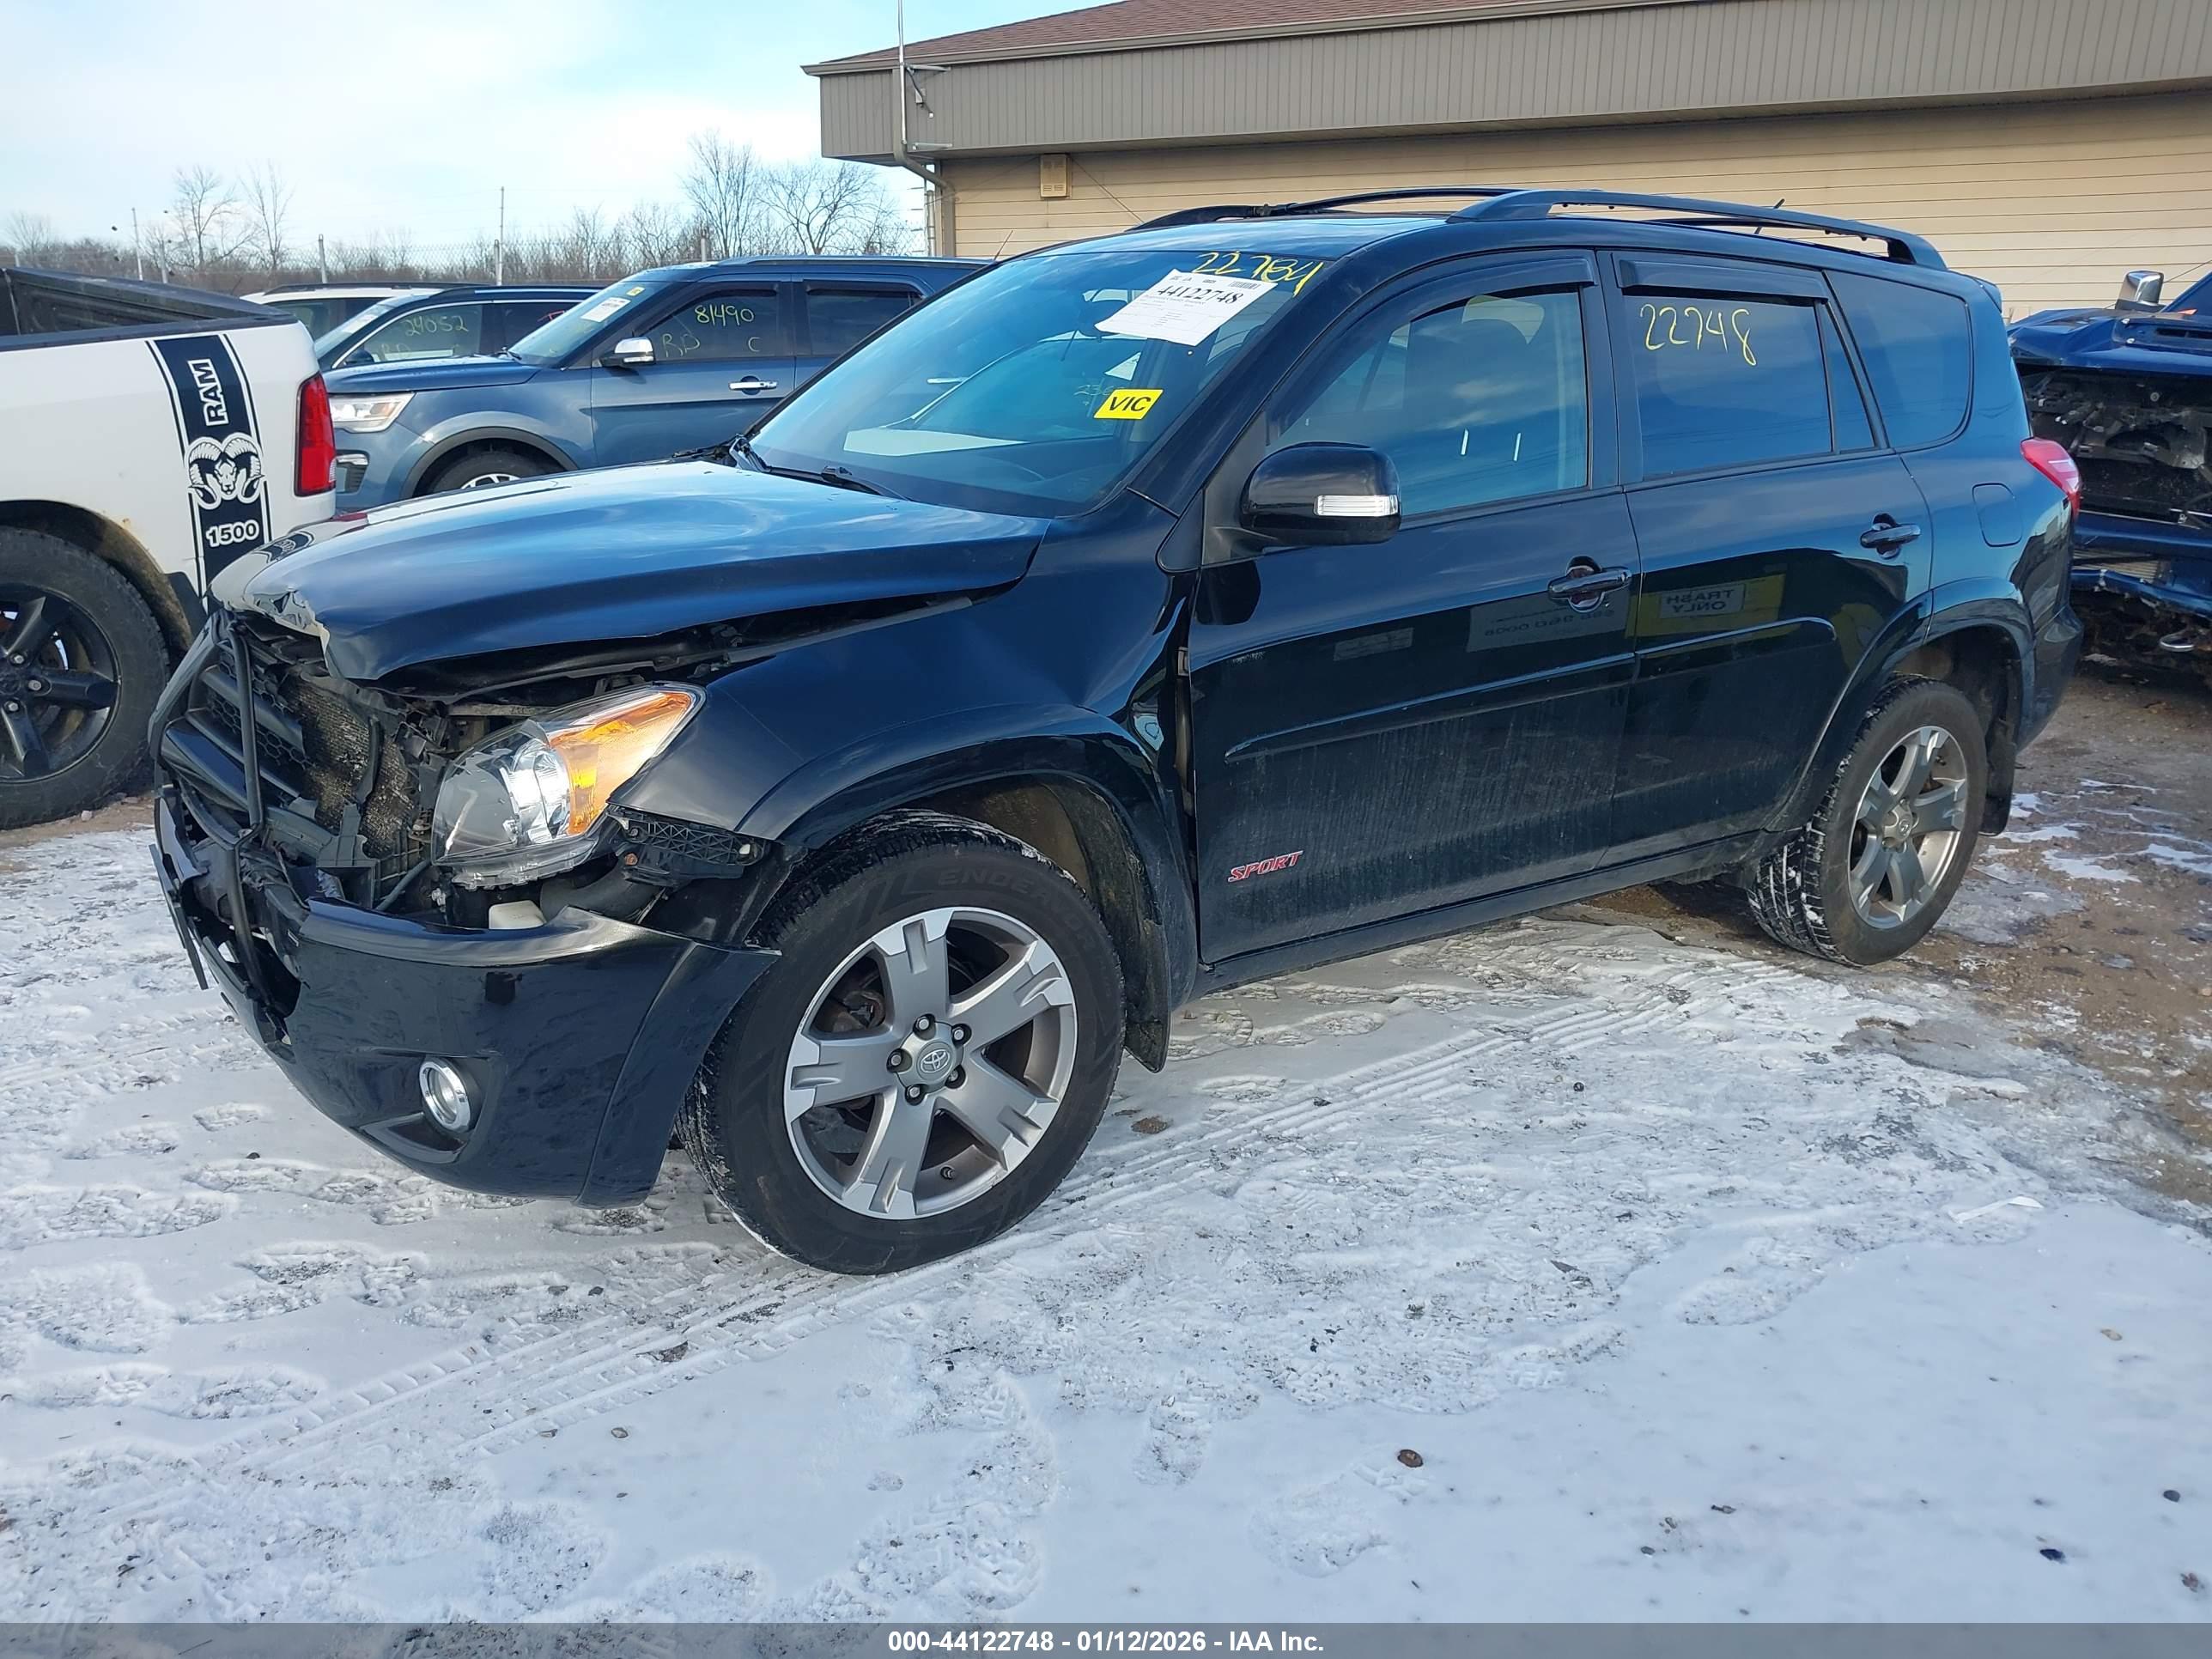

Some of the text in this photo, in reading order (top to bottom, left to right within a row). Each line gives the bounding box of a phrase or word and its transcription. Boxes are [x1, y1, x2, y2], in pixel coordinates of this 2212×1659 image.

[1158, 285, 1244, 304] 44122748
[402, 315, 469, 337] 24052
[695, 303, 755, 326] 81490
[1639, 303, 1757, 366] 22748
[187, 358, 229, 426] RAM
[1109, 396, 1152, 412] VIC
[206, 520, 259, 547] 1500
[1228, 850, 1304, 882] SPORT
